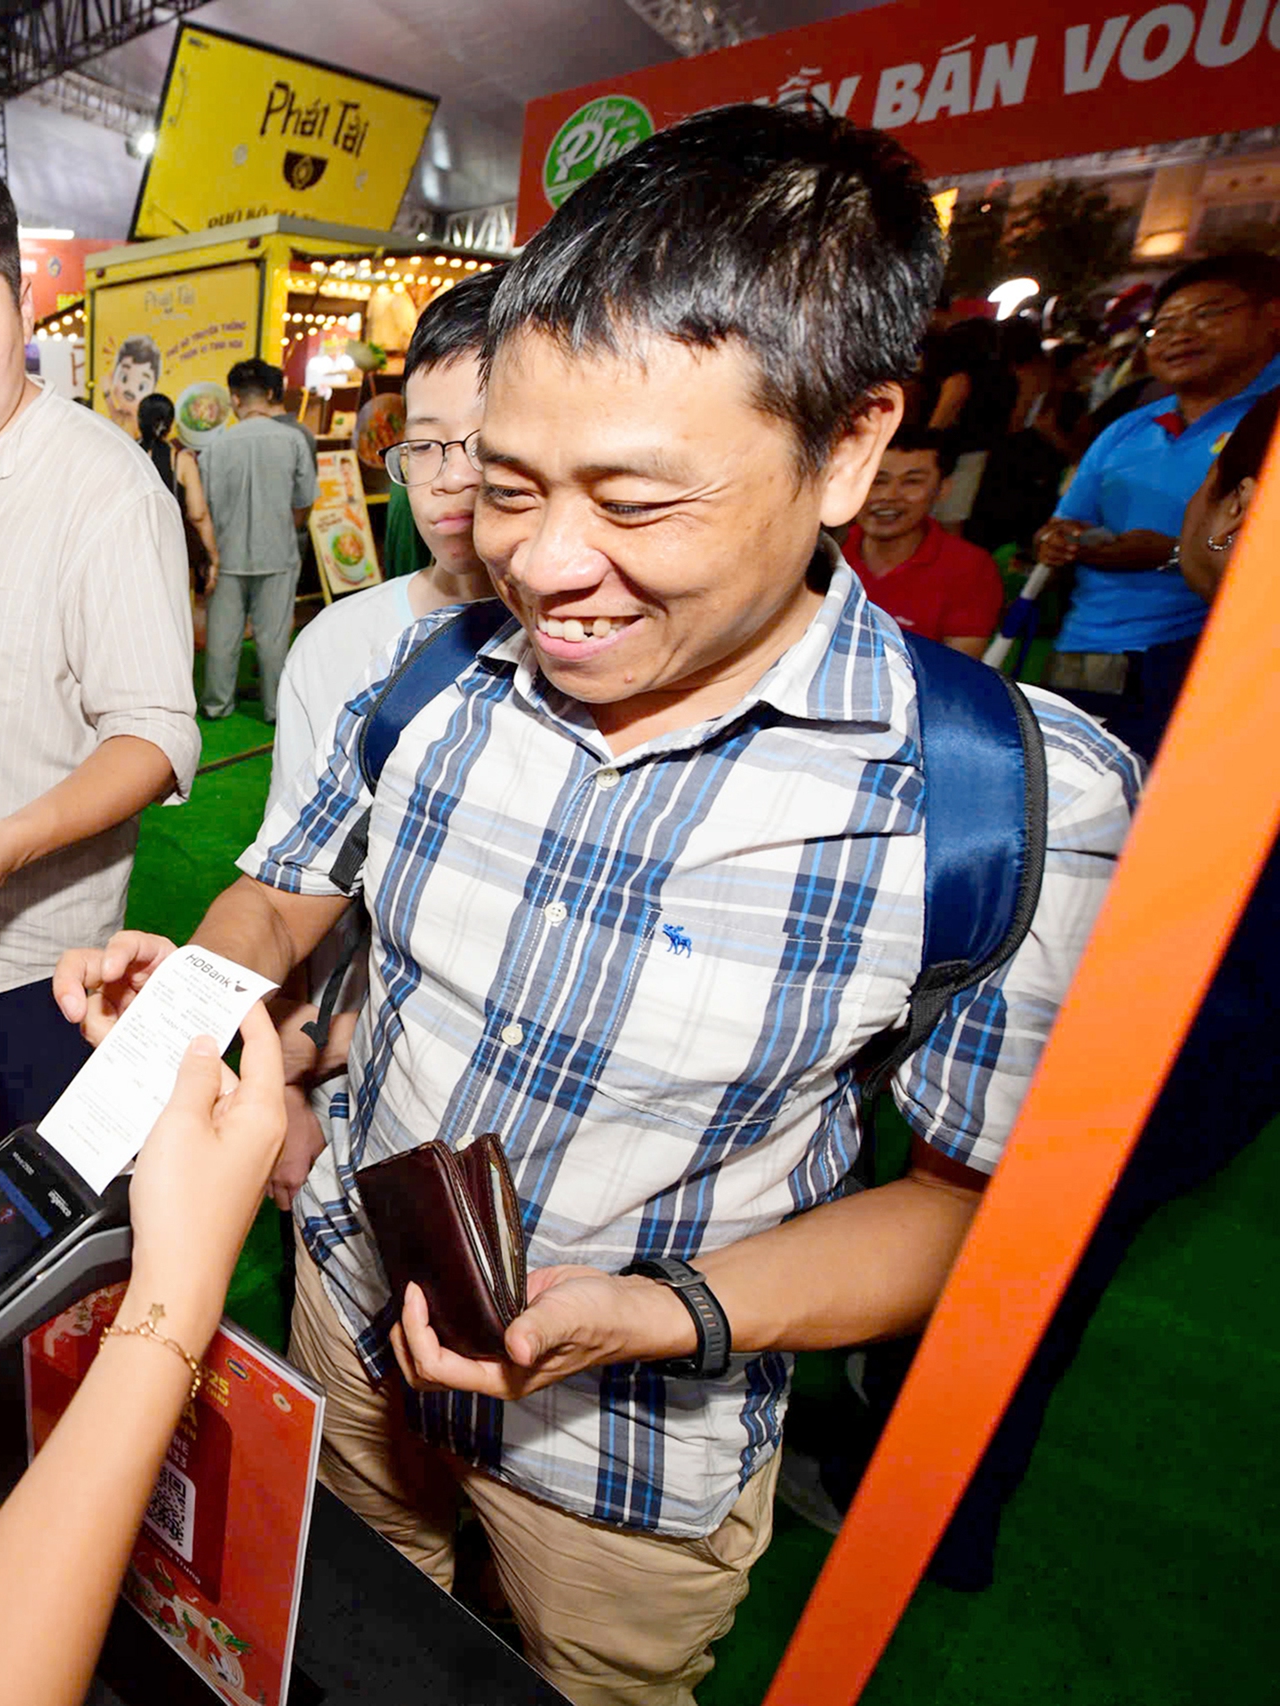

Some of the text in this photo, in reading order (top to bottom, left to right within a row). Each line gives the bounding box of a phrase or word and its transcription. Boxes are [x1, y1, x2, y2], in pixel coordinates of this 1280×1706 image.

[872, 34, 1038, 129] BÁN
[1063, 0, 1280, 95] VOU
[185, 953, 233, 988] HDBank
